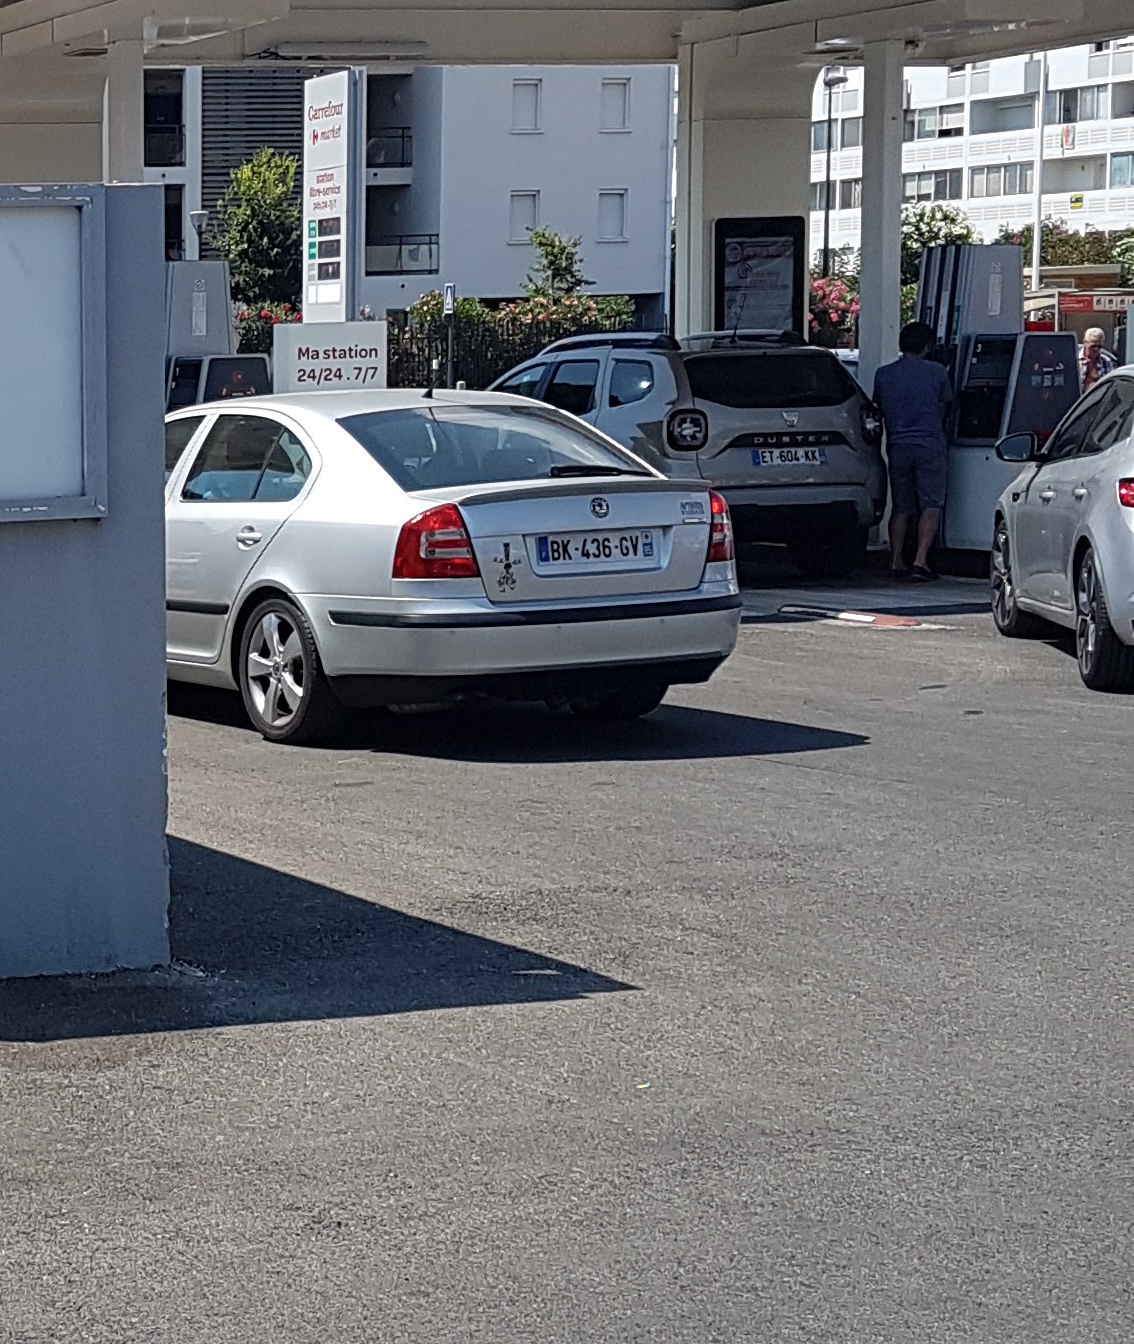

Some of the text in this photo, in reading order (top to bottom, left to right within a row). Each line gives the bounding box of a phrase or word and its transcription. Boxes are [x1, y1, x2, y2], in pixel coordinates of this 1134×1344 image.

[297, 344, 378, 360] Ma station
[754, 435, 829, 444] DUSTER
[550, 535, 639, 561] BK-436-GV
